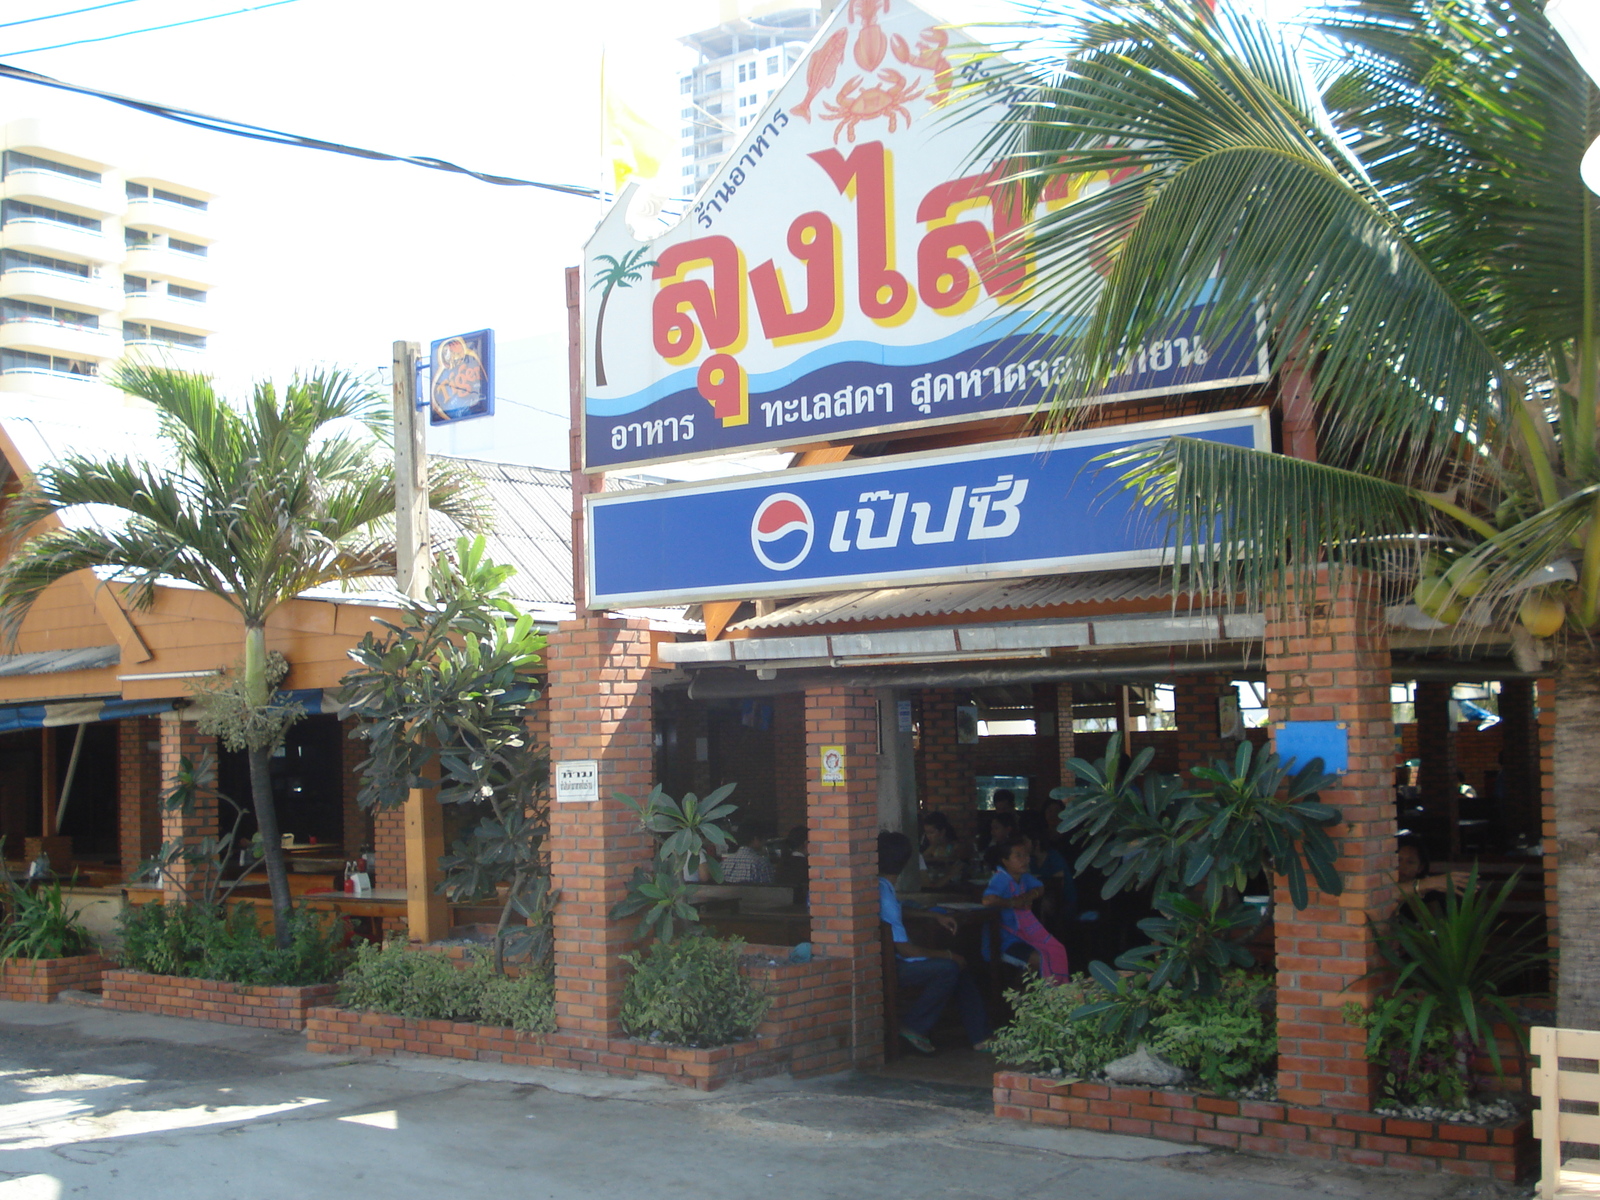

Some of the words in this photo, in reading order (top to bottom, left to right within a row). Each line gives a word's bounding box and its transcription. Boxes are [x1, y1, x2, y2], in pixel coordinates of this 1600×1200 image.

[694, 107, 789, 230] ร้านอาหาร
[611, 413, 695, 450] อาหาร
[761, 382, 894, 428] ทะเลสดๆ
[829, 474, 1030, 553] เป๊ปซี่
